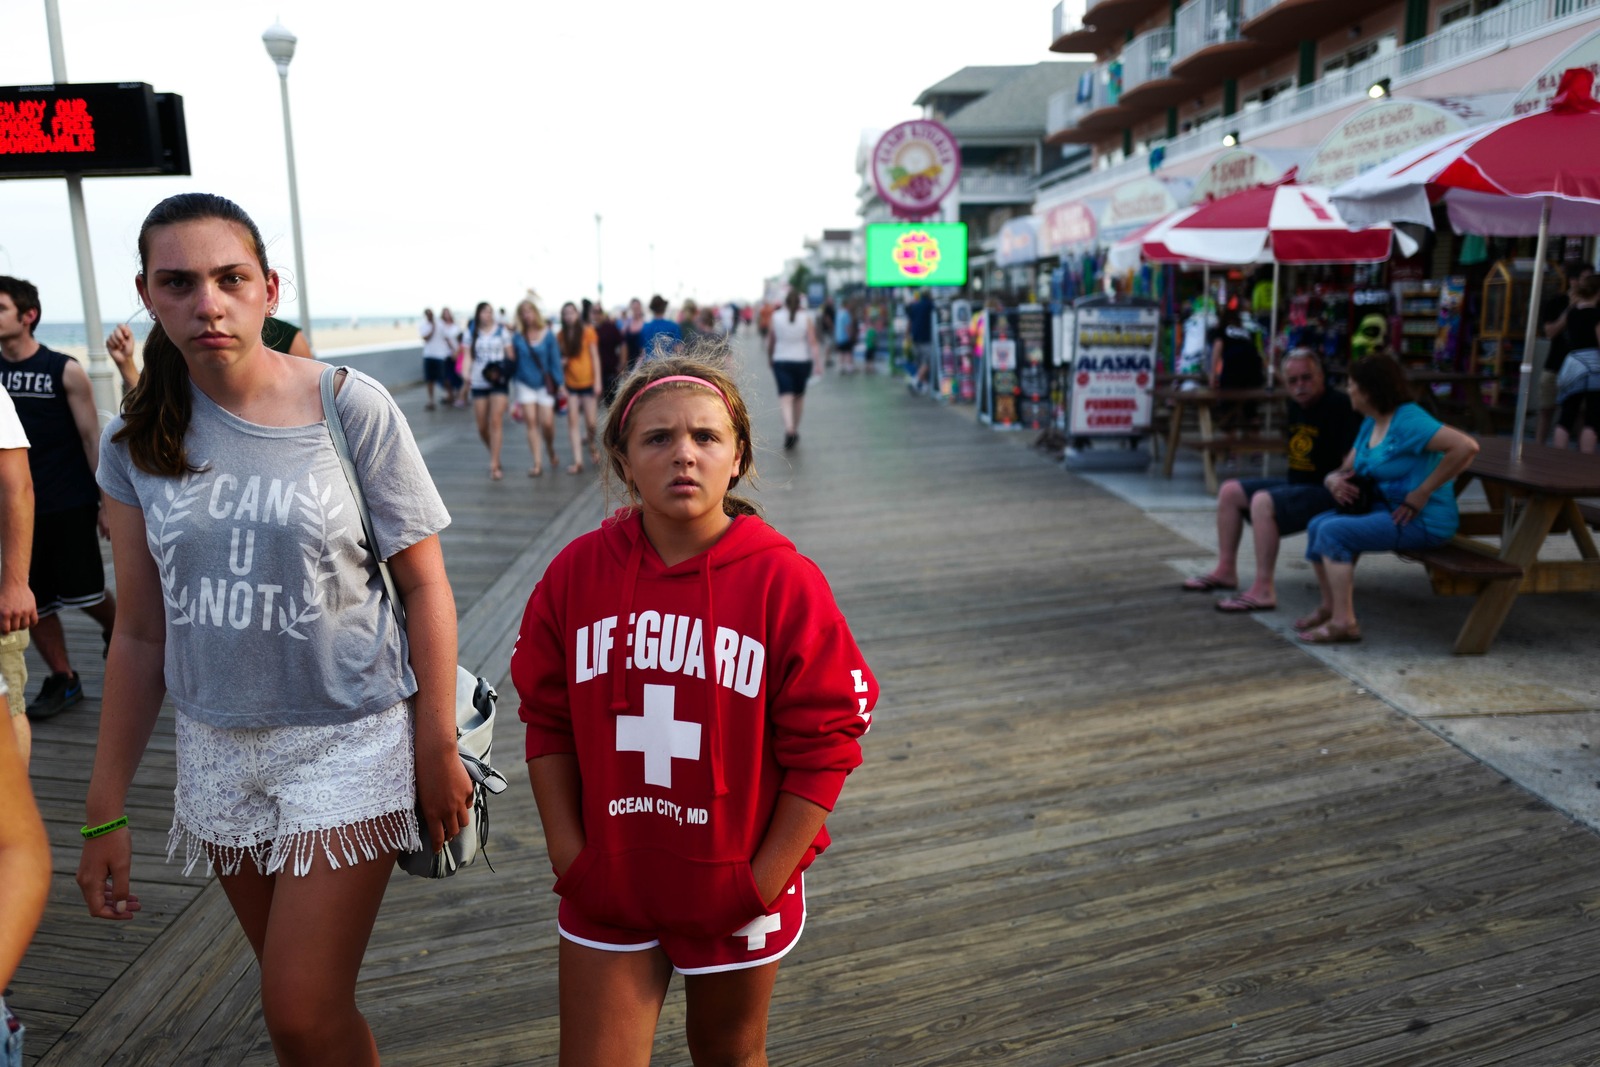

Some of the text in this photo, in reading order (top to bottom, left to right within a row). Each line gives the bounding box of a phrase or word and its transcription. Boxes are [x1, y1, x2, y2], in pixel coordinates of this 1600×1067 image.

[56, 98, 88, 117] OUR
[1077, 354, 1152, 371] ALASKA
[207, 473, 296, 526] CAN
[229, 528, 254, 577] U
[198, 576, 283, 632] NOT
[575, 610, 766, 698] LIFEGUARD
[608, 796, 709, 827] OCEAN CITY, MD
